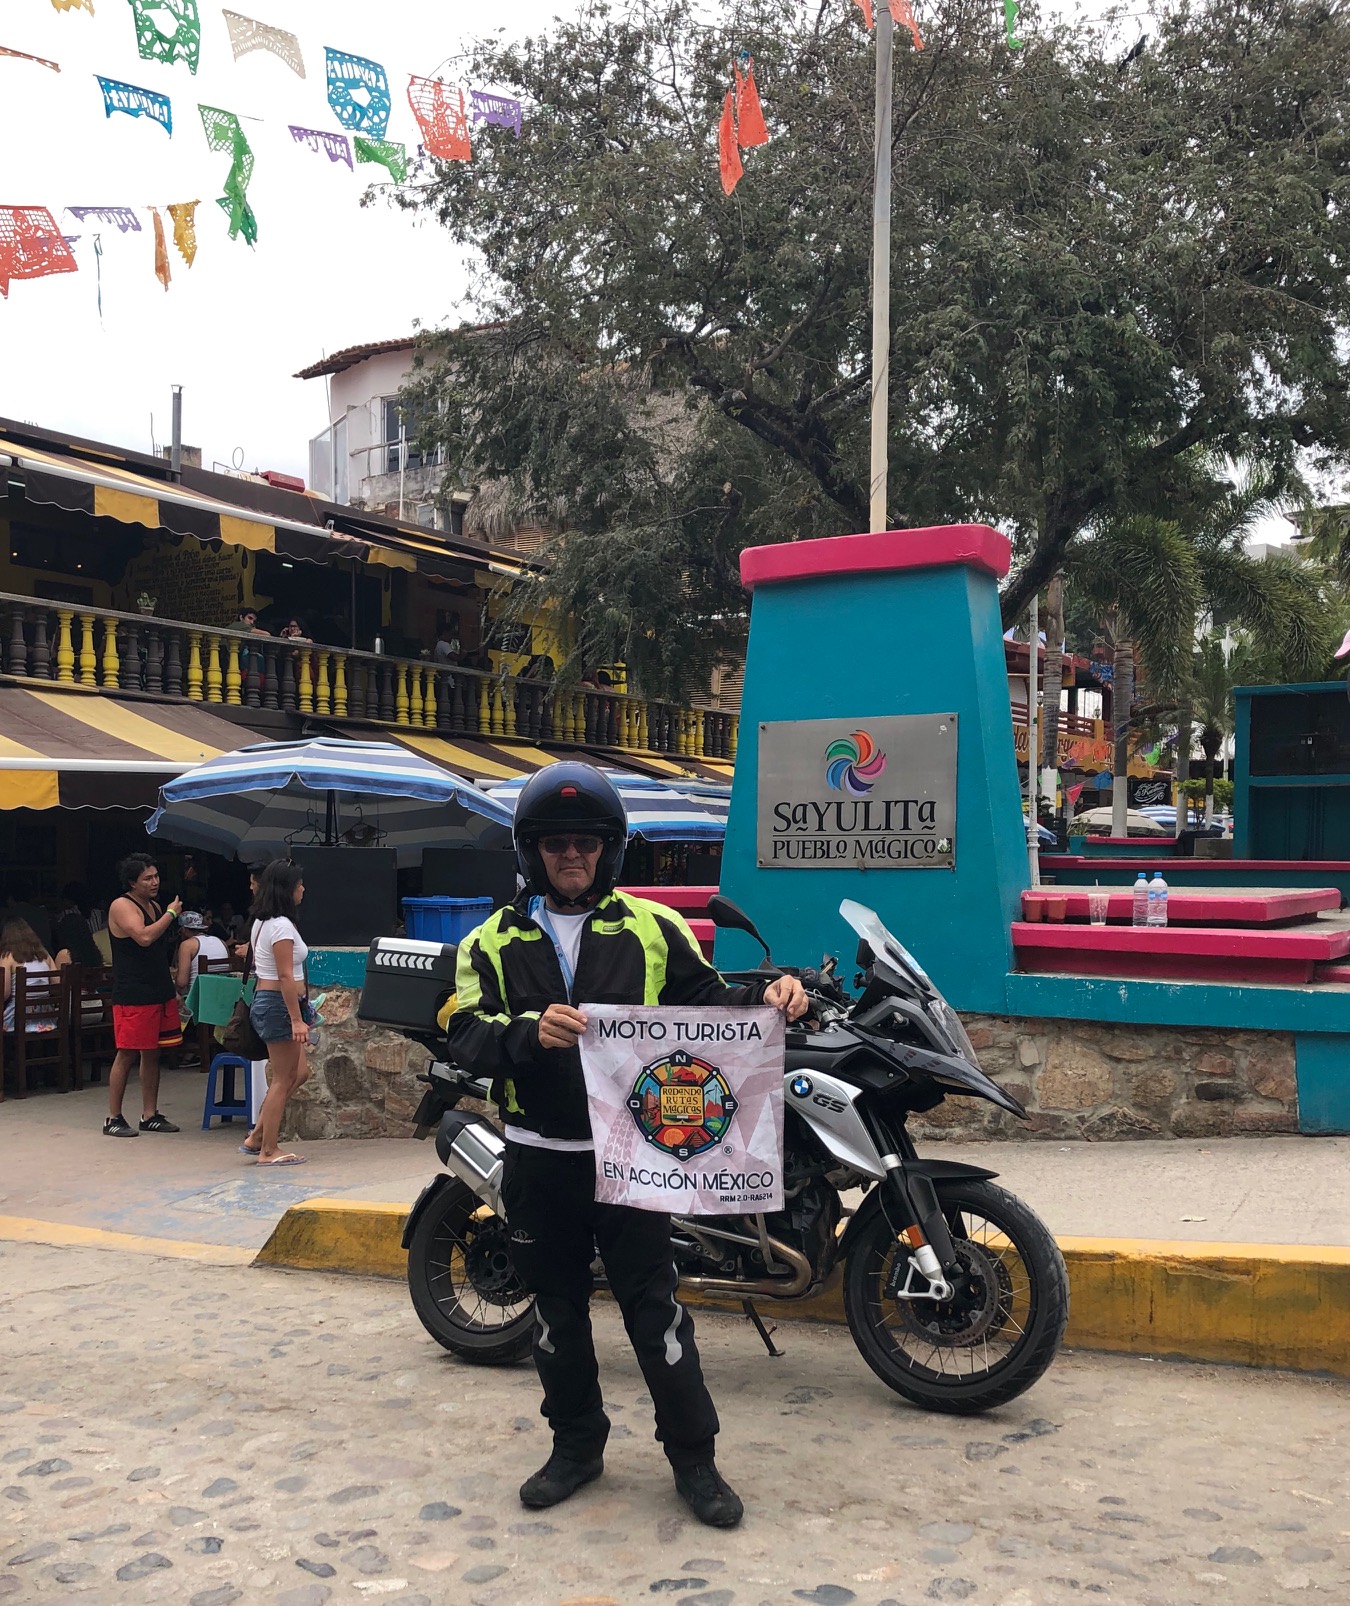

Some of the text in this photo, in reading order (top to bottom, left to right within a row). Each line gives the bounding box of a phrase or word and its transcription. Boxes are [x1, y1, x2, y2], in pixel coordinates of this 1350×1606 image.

[598, 1019, 762, 1041] MOTO TURISTA
[675, 1054, 687, 1063] N
[630, 1099, 640, 1108] O
[725, 1101, 734, 1109] E
[812, 1093, 848, 1113] GS
[678, 1148, 689, 1156] S
[603, 1161, 774, 1190] EN ACCIÓN MÉXICO
[719, 1195, 736, 1203] RRM
